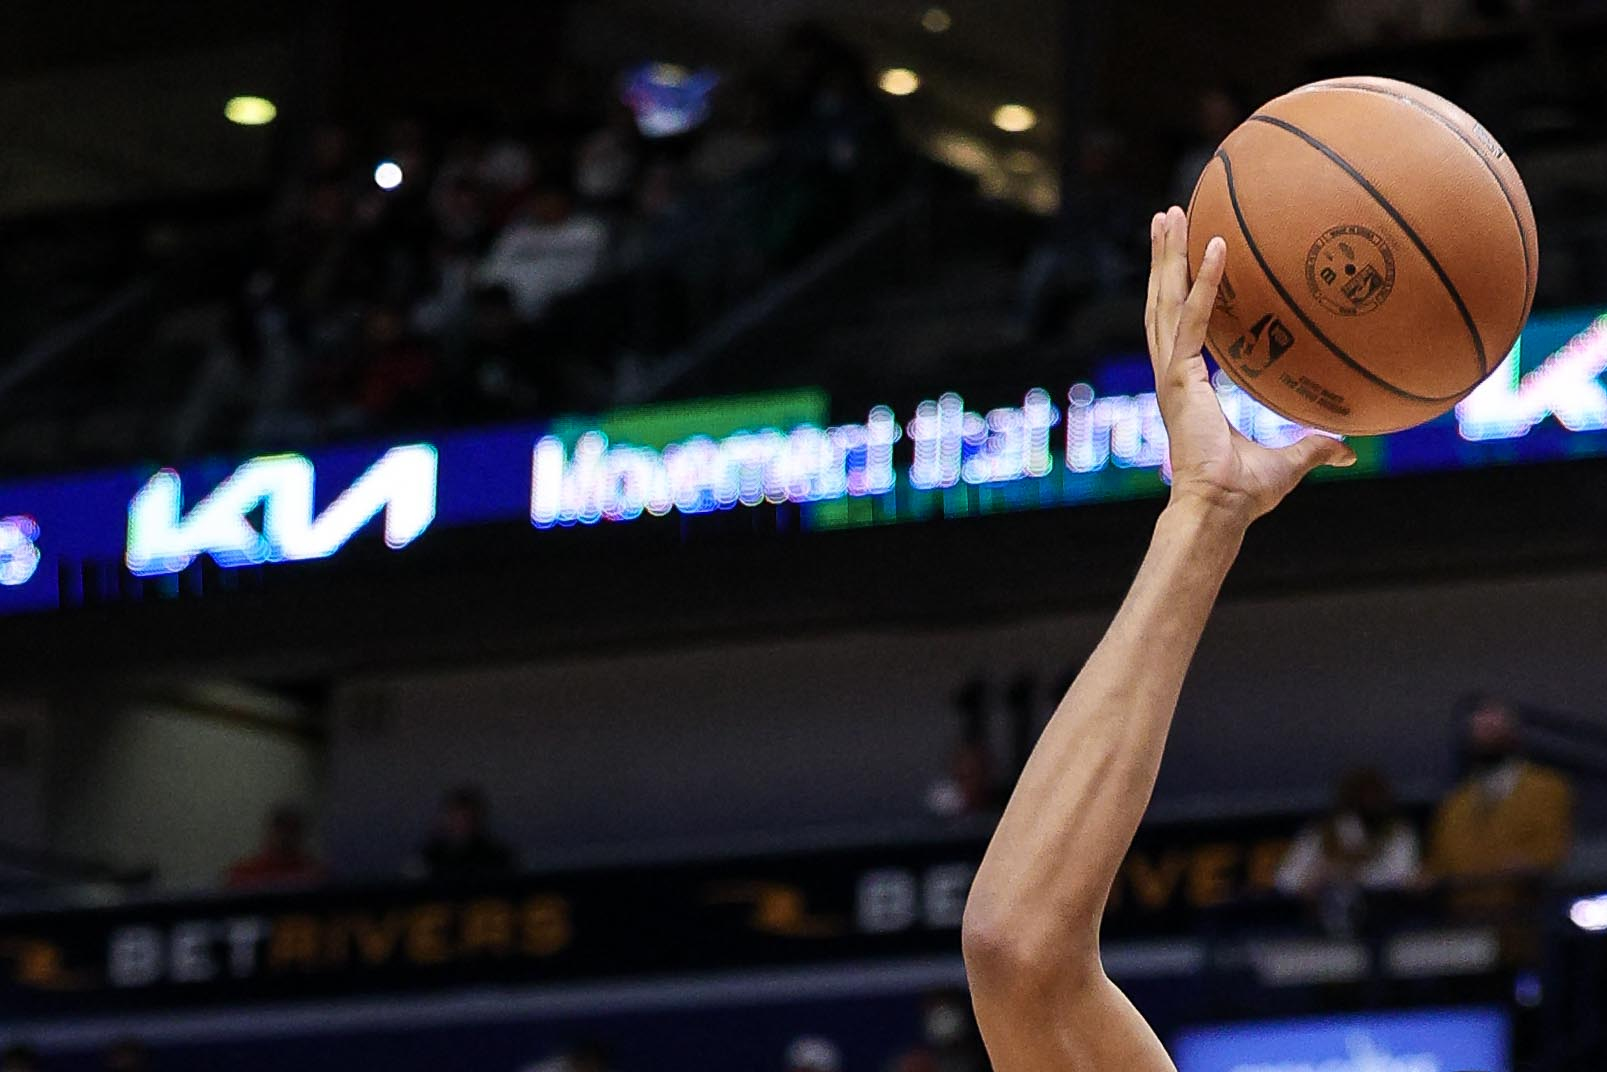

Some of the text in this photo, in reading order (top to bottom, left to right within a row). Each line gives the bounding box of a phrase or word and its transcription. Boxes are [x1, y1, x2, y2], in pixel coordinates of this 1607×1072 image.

[530, 404, 901, 529] Movement
[908, 390, 1061, 489] that
[106, 895, 574, 990] BETRIVERS
